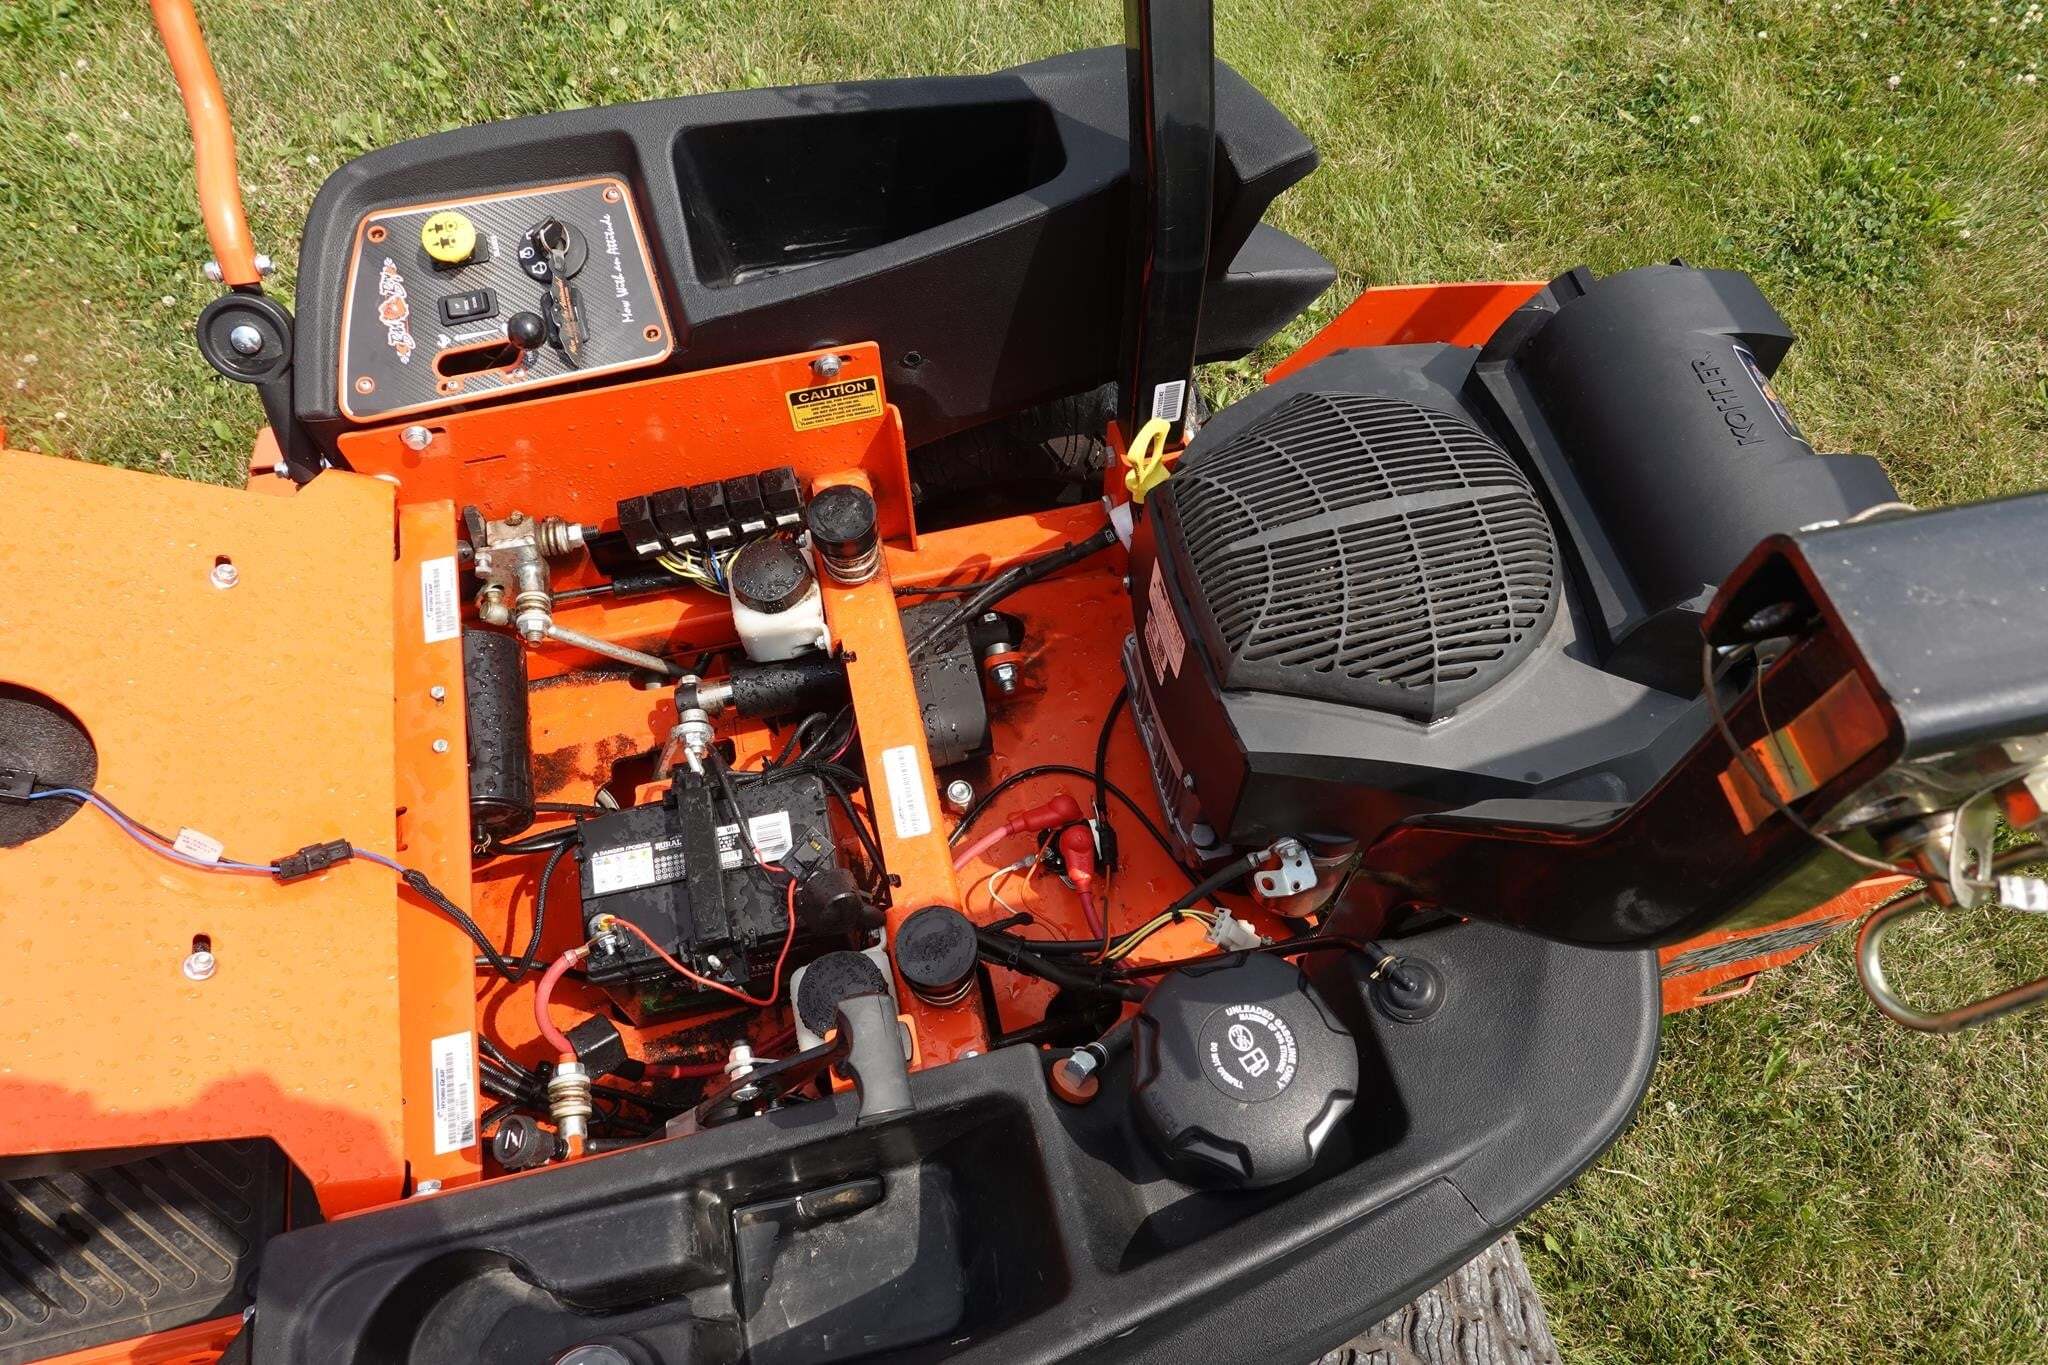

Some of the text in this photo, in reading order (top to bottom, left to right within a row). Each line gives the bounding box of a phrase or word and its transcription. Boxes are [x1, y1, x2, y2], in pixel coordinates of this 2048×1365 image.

[599, 213, 634, 322] Mow With an Attitude
[798, 381, 868, 403] CAUTION
[1691, 350, 1765, 446] KOHLER
[654, 839, 682, 851] RURAL
[1210, 1042, 1244, 1089] DO NOT OVERFILL
[1225, 1004, 1297, 1090] UNLEADED GASOLINE ONLY
